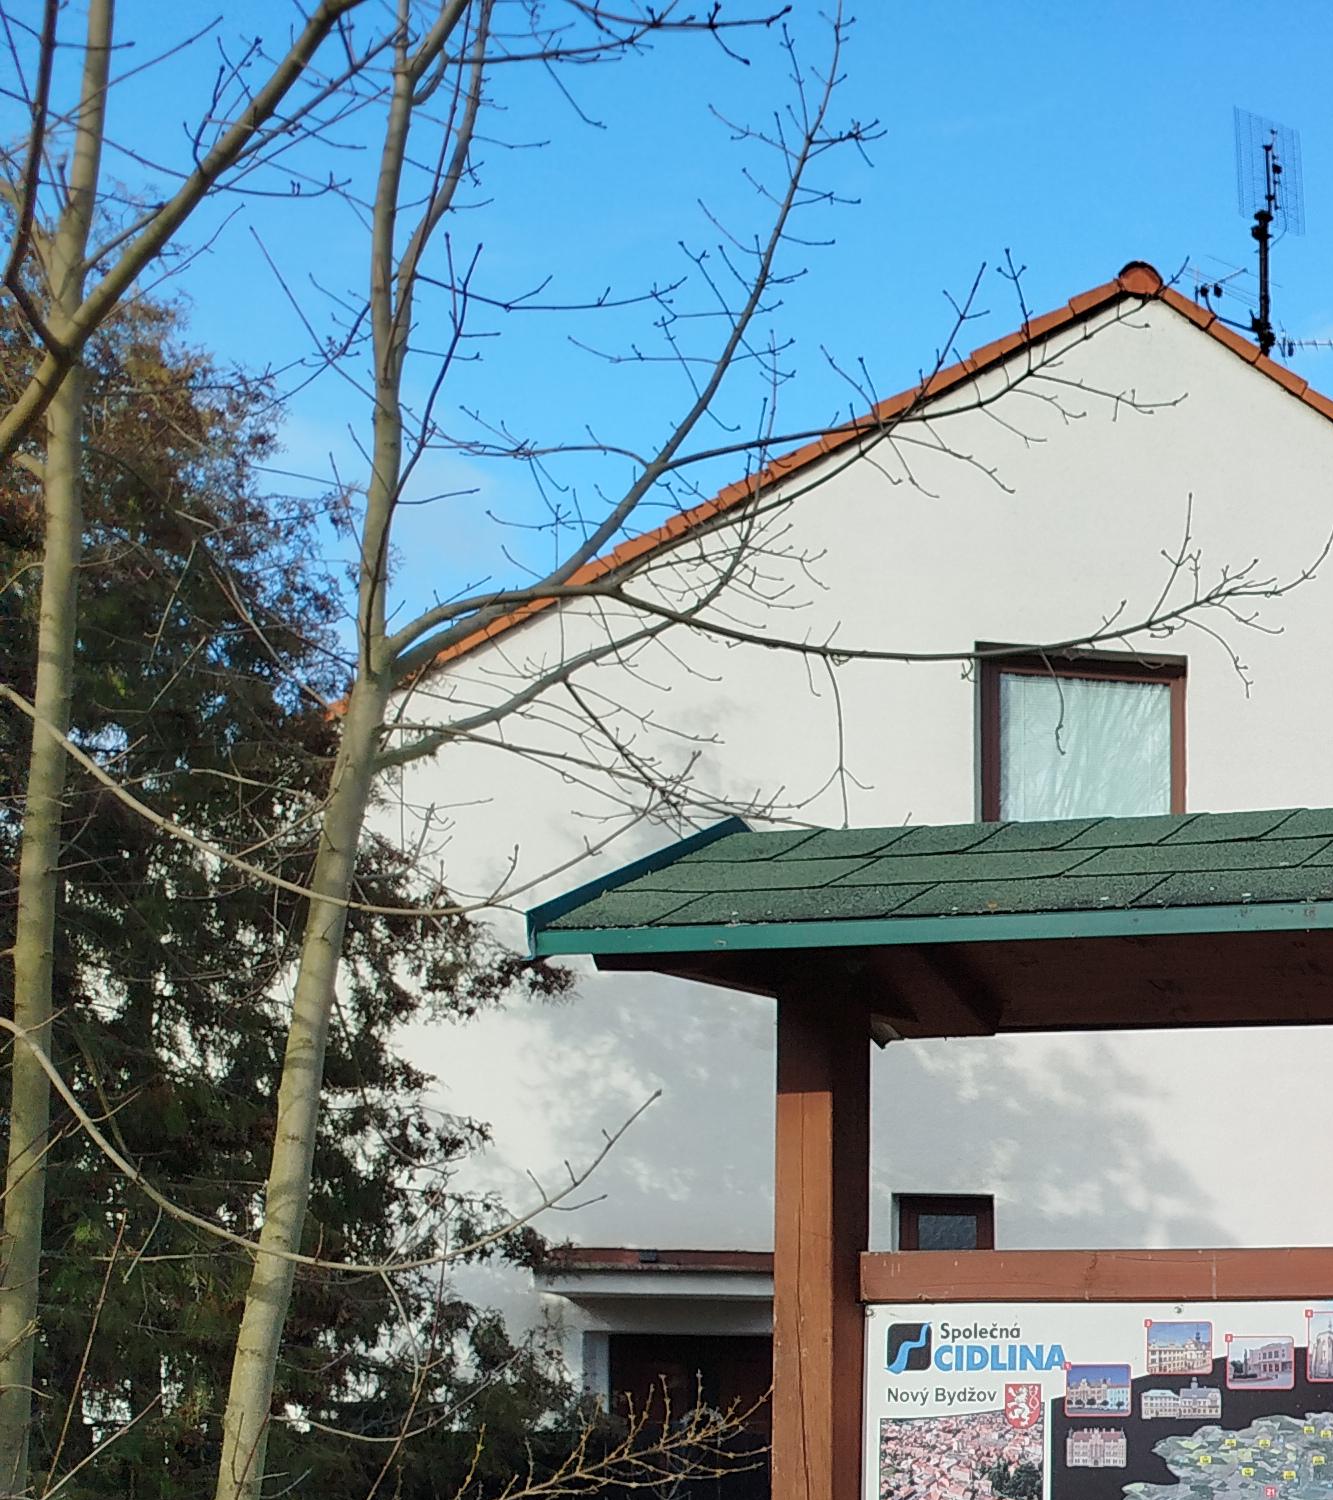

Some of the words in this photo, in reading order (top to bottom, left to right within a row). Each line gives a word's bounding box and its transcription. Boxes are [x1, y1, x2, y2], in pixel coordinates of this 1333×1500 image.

[941, 1322, 1021, 1343] Společná
[934, 1344, 1066, 1371] CIDLINA
[887, 1387, 929, 1405] Nový
[935, 1386, 998, 1406] Bydžov
[1265, 1487, 1276, 1497] 21
